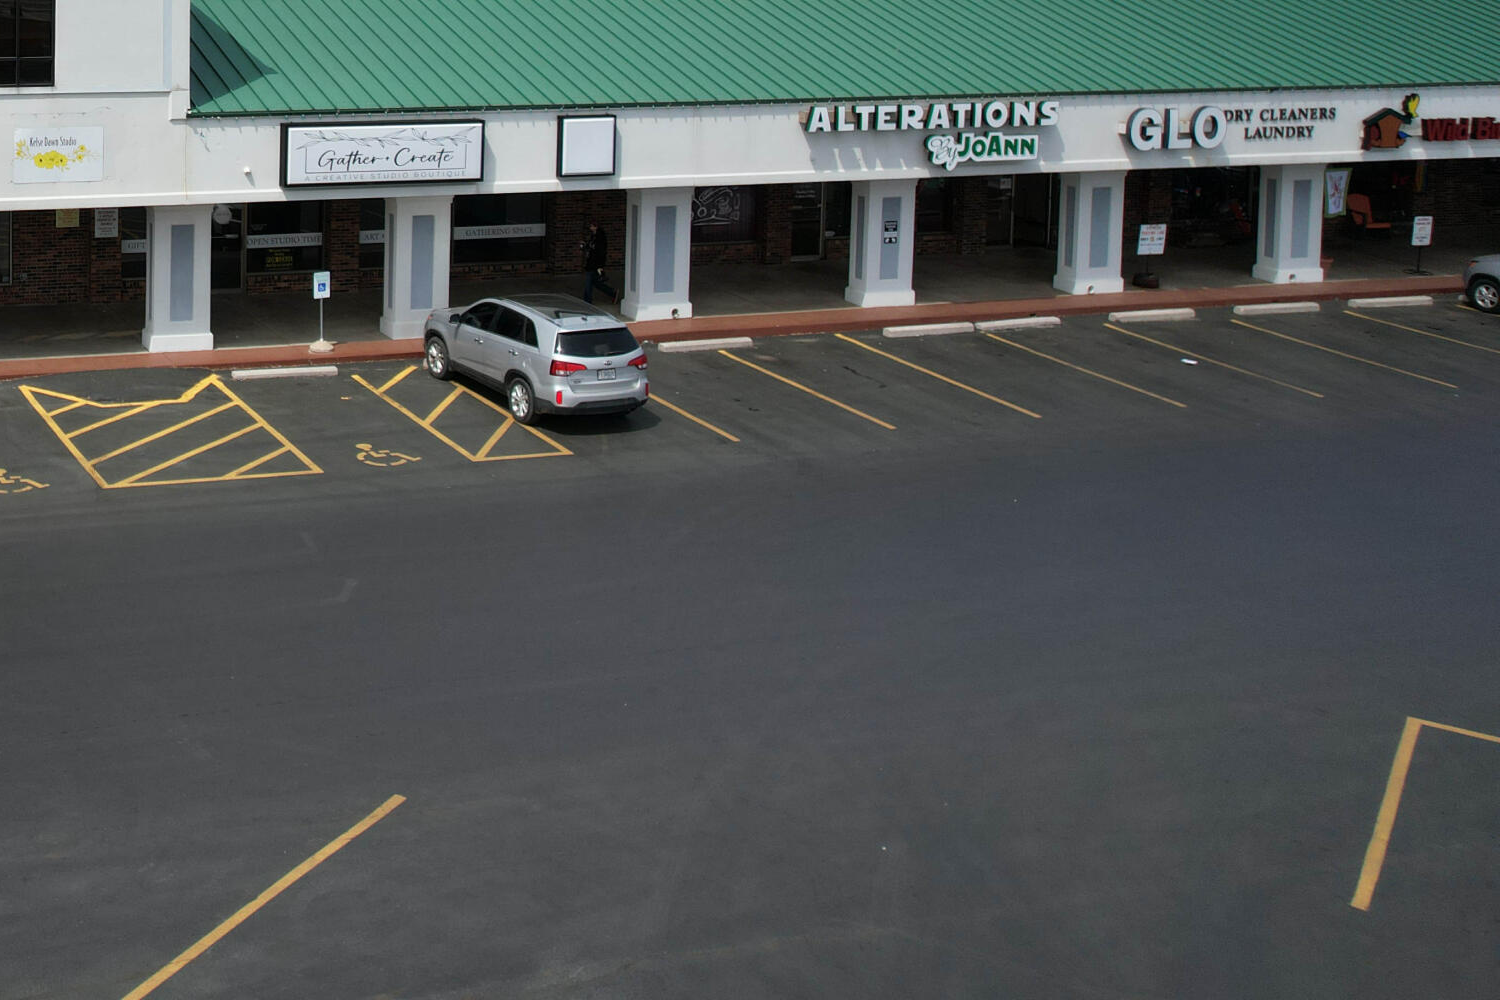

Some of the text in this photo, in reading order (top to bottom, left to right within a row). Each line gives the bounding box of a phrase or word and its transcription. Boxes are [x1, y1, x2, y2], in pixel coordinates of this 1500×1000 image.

[806, 101, 1060, 132] ALTERATIONS
[1224, 107, 1336, 122] DRY CLEANERS
[1127, 106, 1227, 150] GLO
[1244, 125, 1314, 139] LAUNDRY
[60, 136, 77, 146] Studio
[317, 147, 454, 171] Gather Create
[315, 173, 365, 181] CREATIVE
[370, 171, 409, 180] STUDIO
[413, 170, 467, 178] BOUTIQUE
